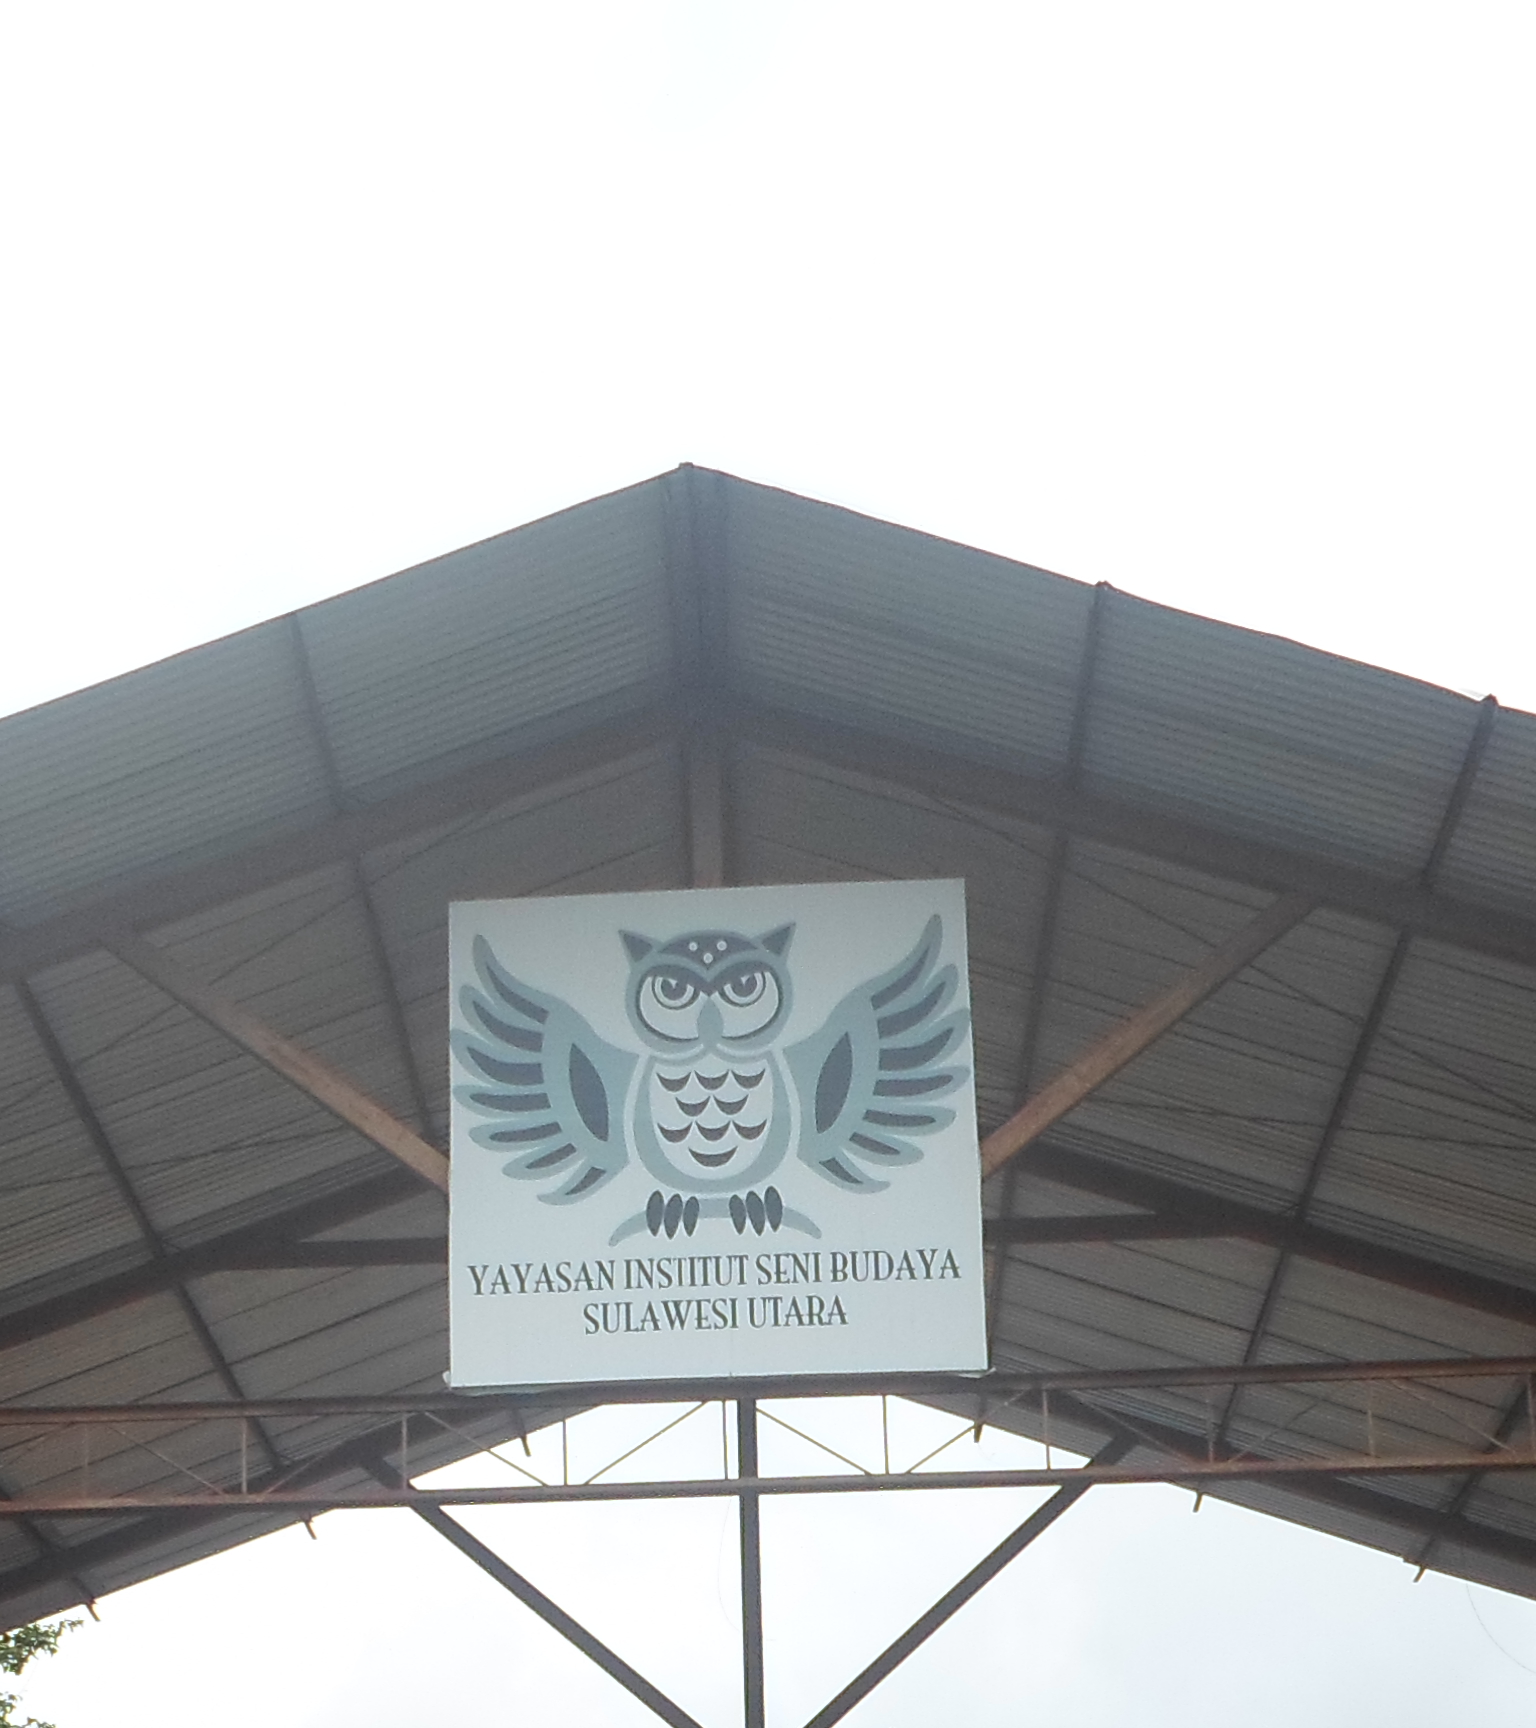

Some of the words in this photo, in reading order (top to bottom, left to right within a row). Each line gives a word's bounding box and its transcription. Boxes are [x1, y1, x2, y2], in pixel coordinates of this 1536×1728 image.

[466, 1259, 617, 1296] YAYASAN
[624, 1254, 749, 1290] INSTITUT
[755, 1252, 823, 1286] SENI
[830, 1248, 962, 1284] BUDAYA
[583, 1297, 739, 1335] SULAWESI
[747, 1294, 849, 1329] UTARA
